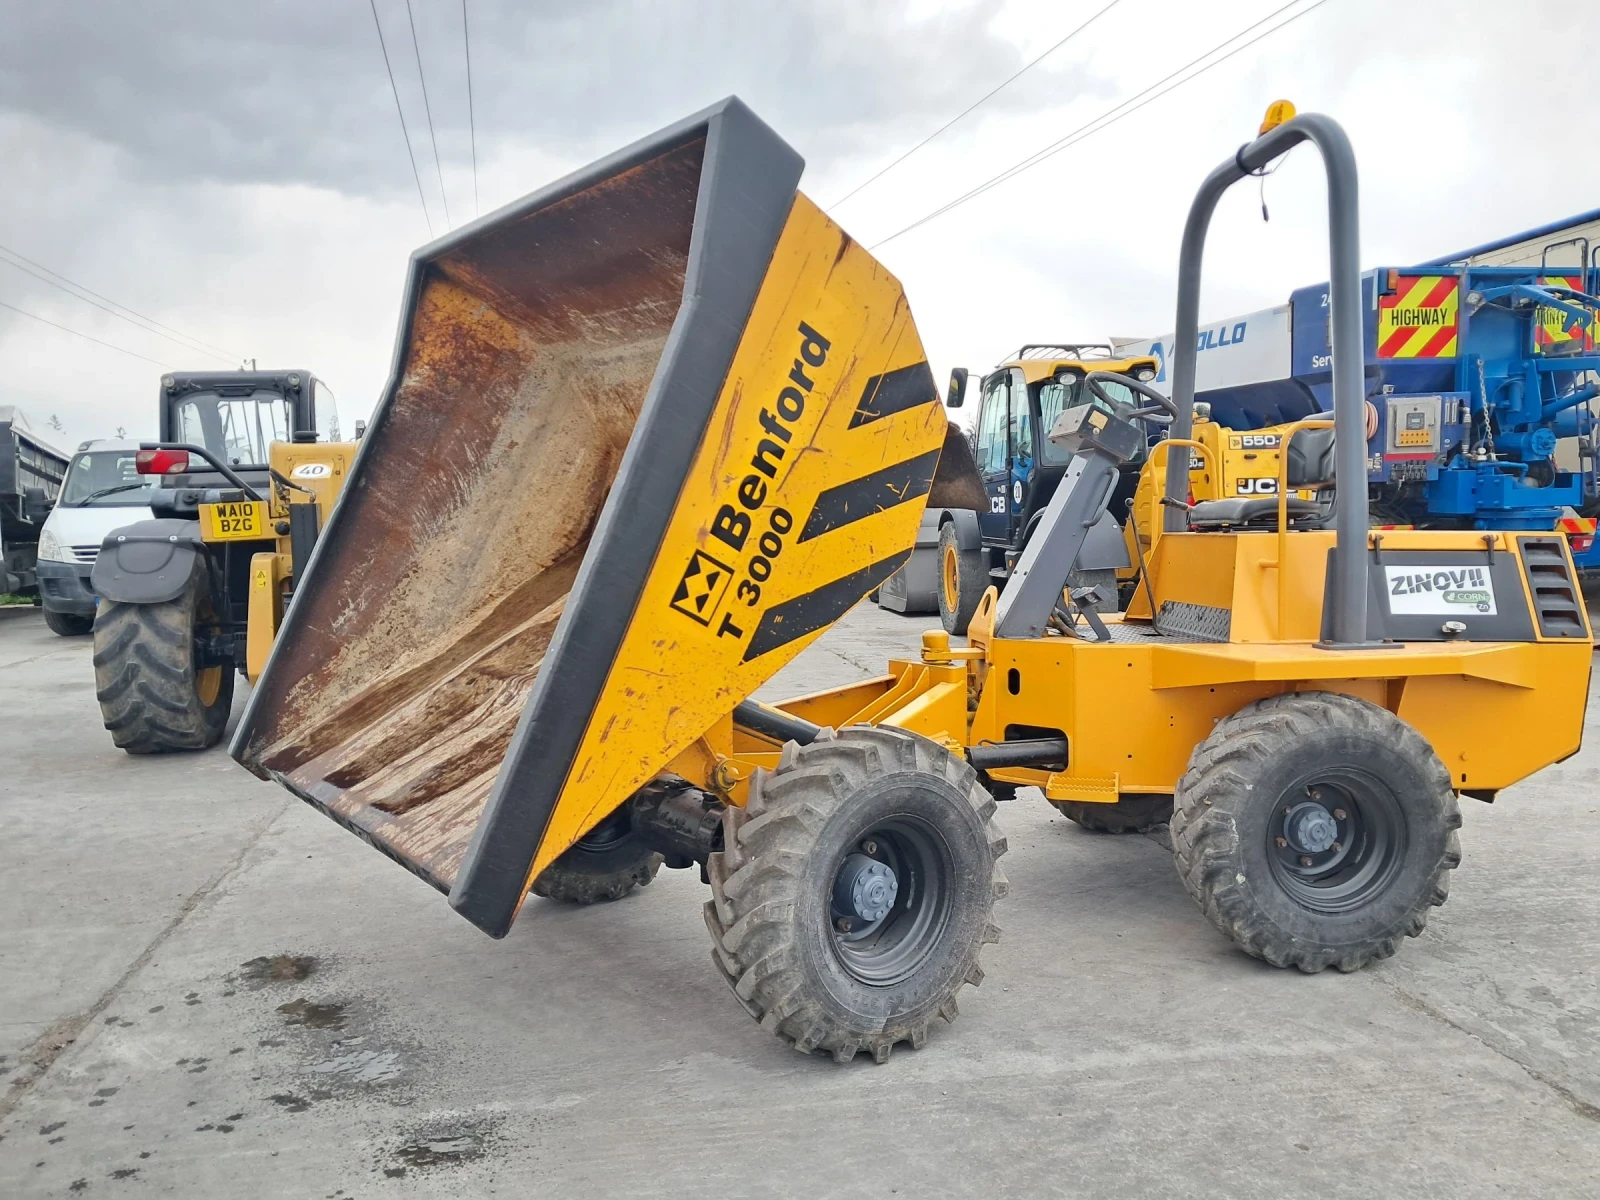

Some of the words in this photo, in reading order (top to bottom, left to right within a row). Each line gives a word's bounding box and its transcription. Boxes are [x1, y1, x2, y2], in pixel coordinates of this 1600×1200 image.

[1391, 308, 1448, 326] HIGHWAY
[1312, 354, 1334, 368] Serv
[710, 320, 832, 552] Benford
[299, 465, 324, 476] 40
[216, 503, 253, 518] WA10
[988, 496, 1006, 513] CB
[221, 518, 253, 533] BZG
[716, 612, 744, 640] T
[737, 507, 793, 607] 3000
